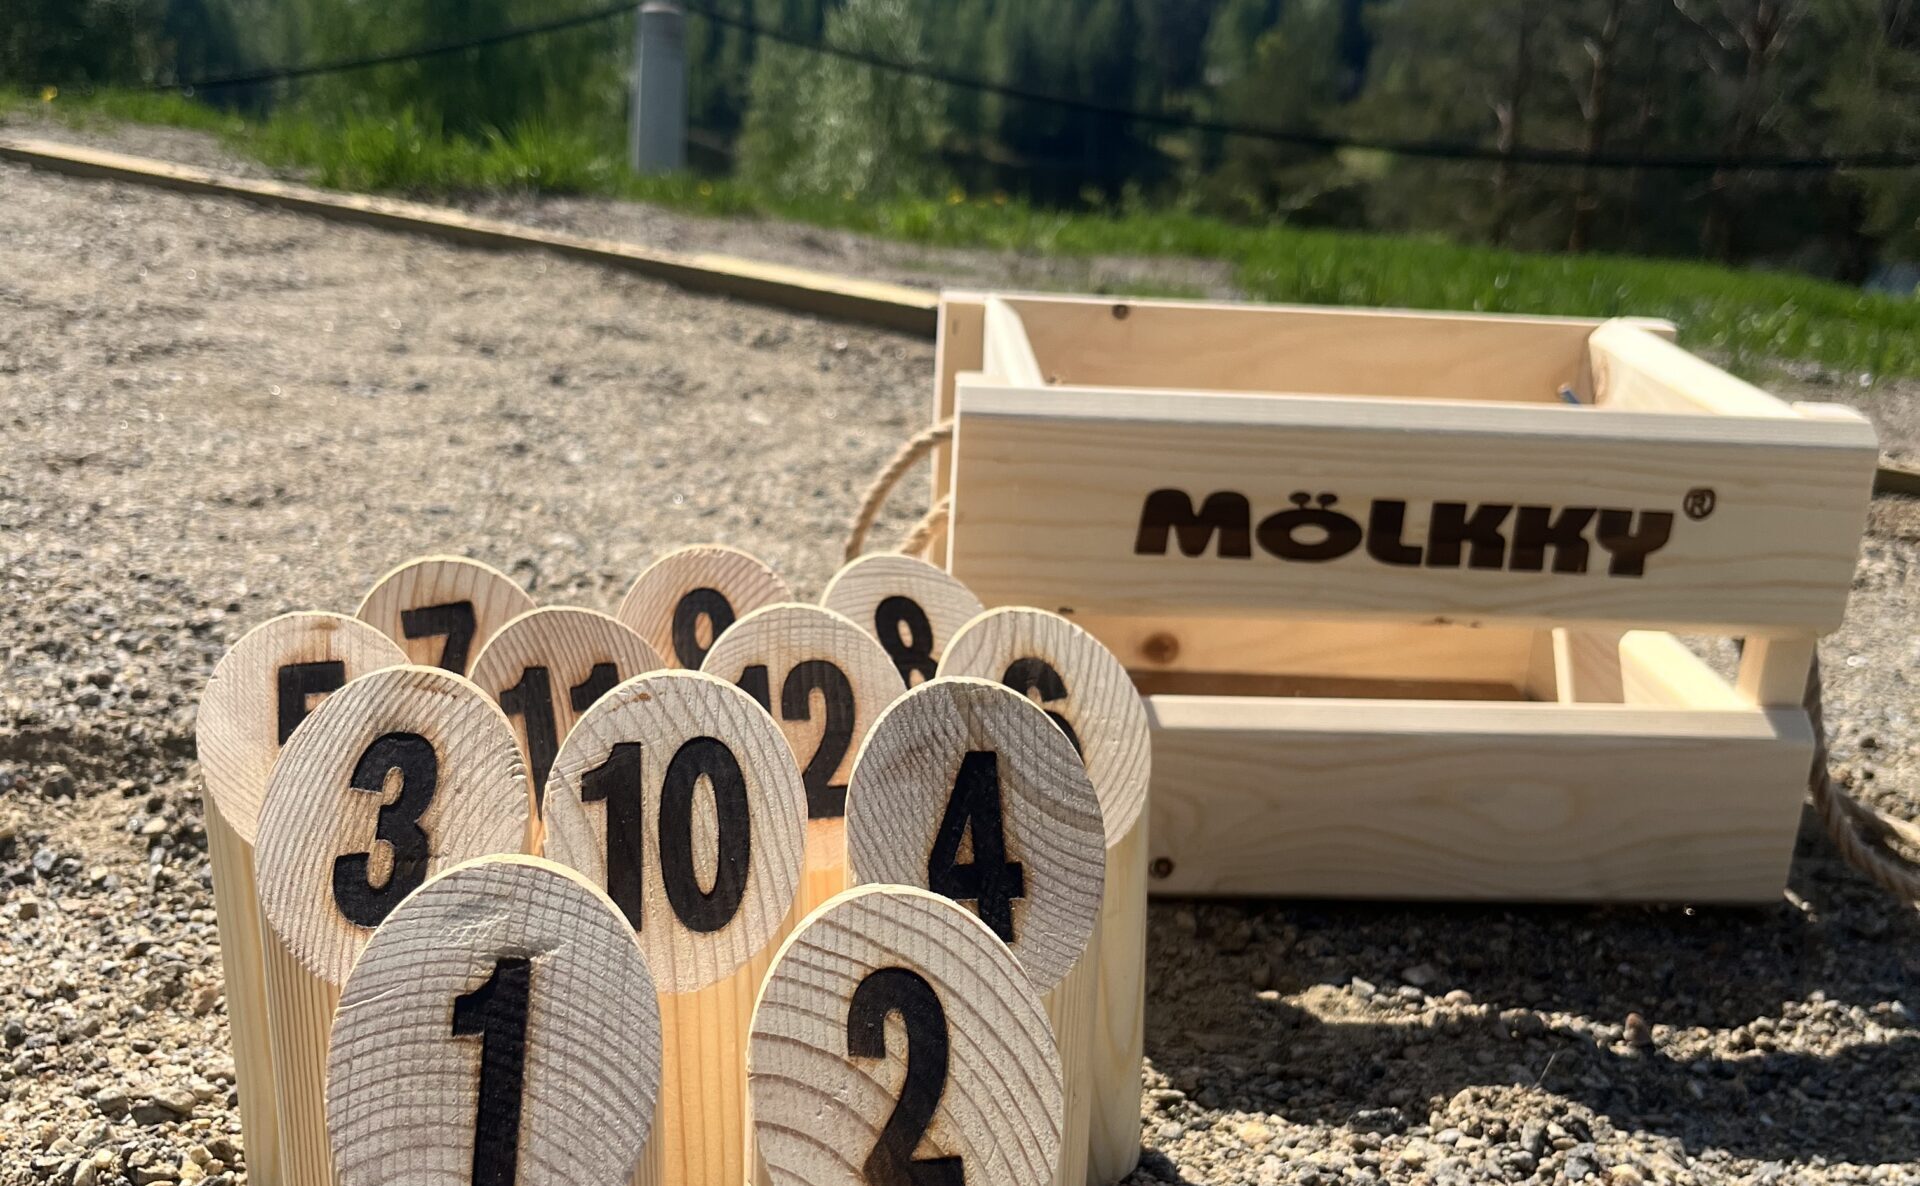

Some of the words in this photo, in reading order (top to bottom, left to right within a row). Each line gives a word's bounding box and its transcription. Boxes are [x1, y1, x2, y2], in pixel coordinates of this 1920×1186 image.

[401, 601, 476, 674] 7
[333, 731, 438, 929] 3
[582, 736, 751, 933] 10
[928, 751, 1025, 943] 4
[452, 957, 531, 1186] 1
[847, 966, 963, 1186] 2
